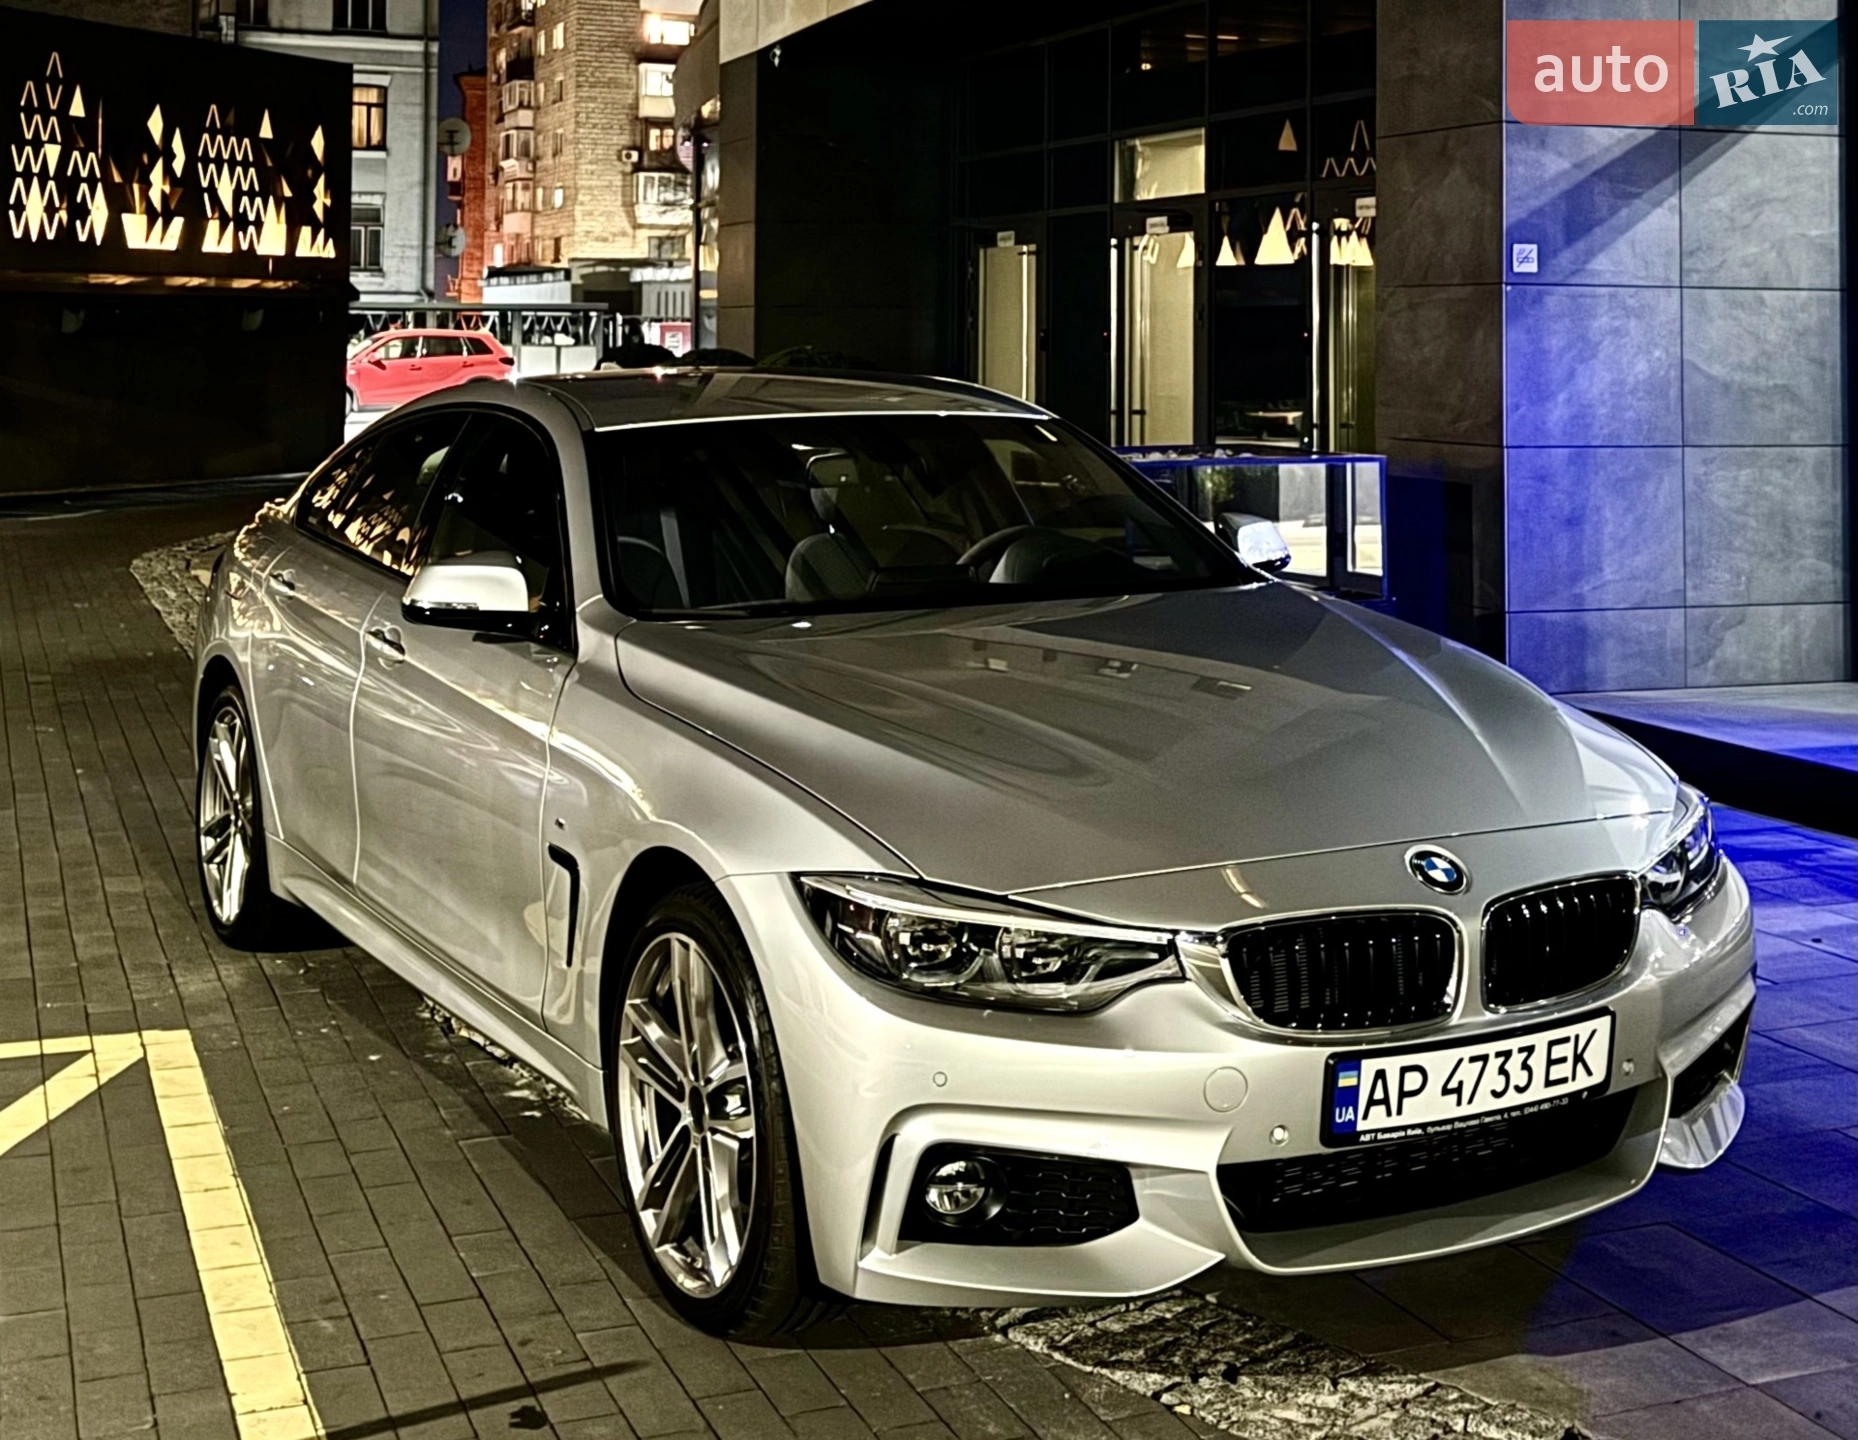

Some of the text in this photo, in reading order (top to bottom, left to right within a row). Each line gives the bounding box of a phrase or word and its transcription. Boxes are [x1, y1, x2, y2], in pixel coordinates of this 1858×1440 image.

[1362, 1028, 1597, 1121] AP 4733 EK
[1335, 1106, 1355, 1123] UA
